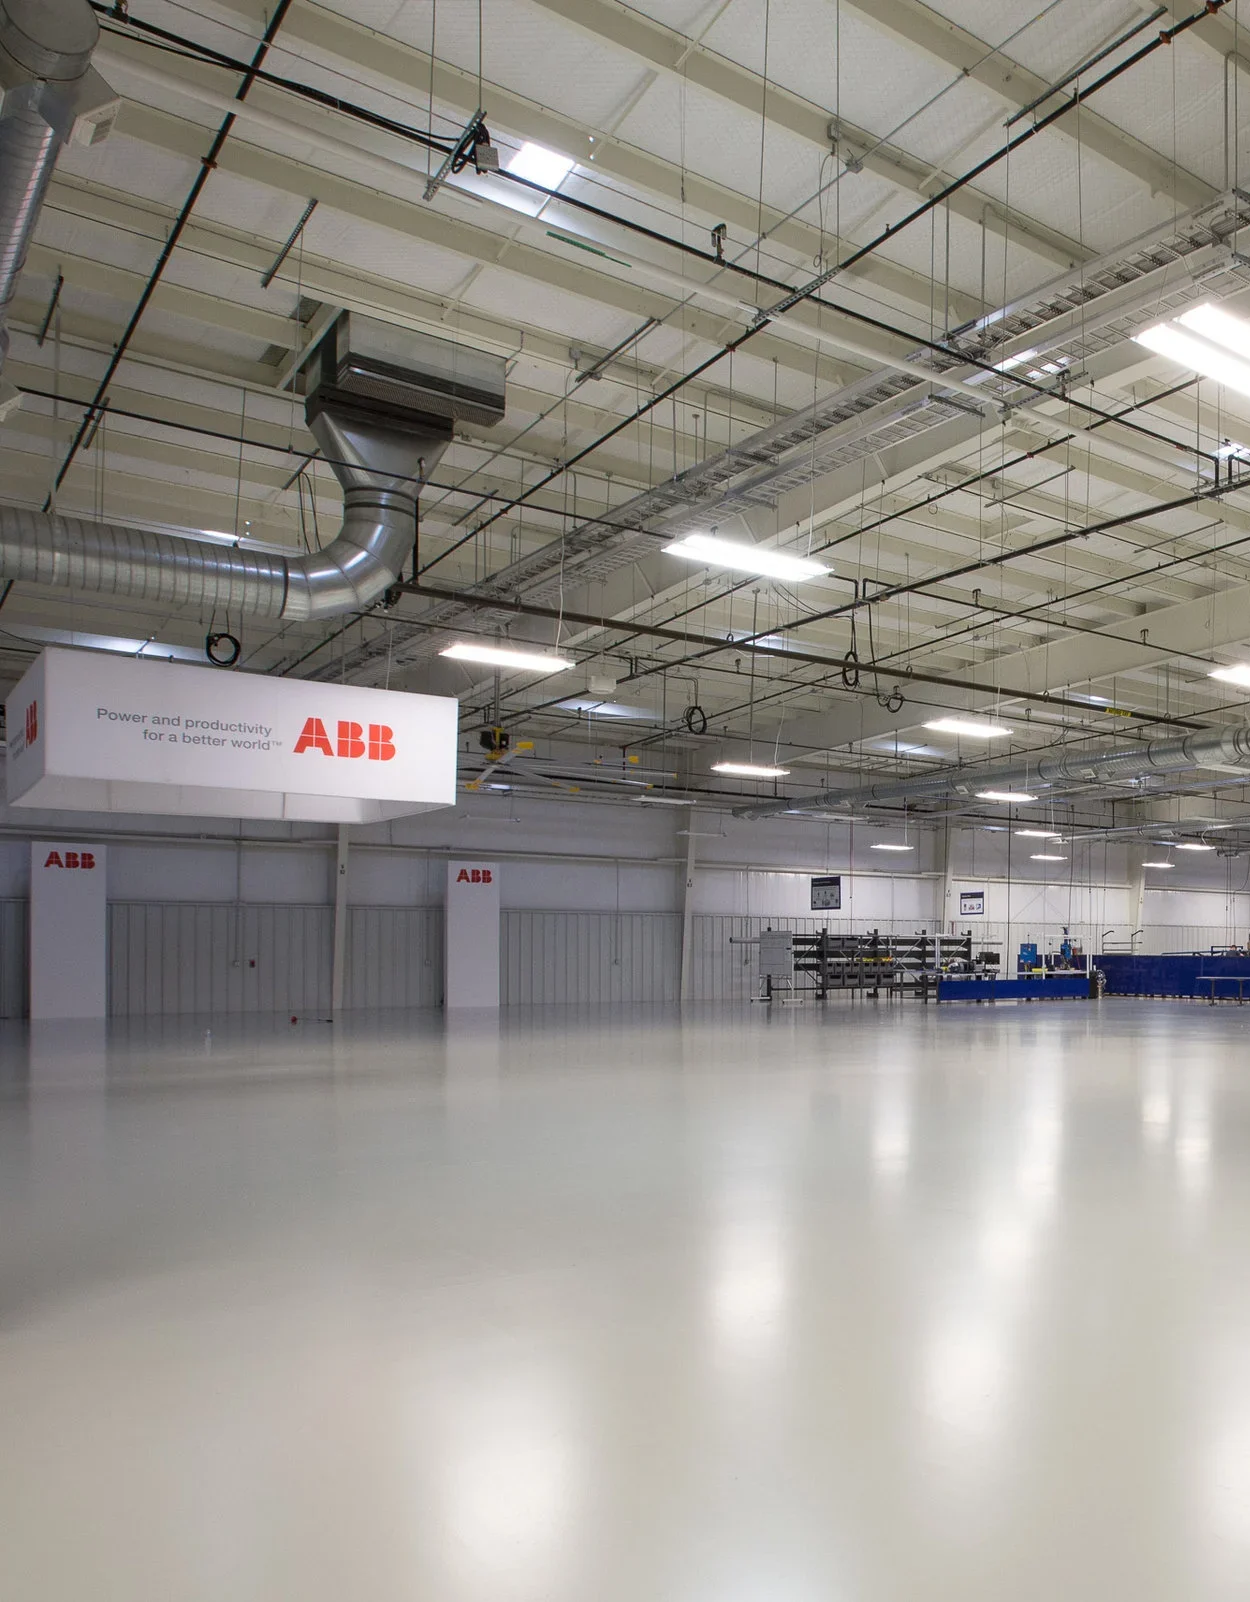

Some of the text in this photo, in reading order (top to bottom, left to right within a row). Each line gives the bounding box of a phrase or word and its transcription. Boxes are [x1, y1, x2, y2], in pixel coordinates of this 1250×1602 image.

[97, 708, 272, 737] Power and productivity
[142, 729, 165, 741] for
[168, 734, 178, 743] a
[182, 732, 227, 746] better
[293, 717, 396, 761] ABB
[44, 851, 95, 869] ABB
[456, 868, 492, 883] ABB
